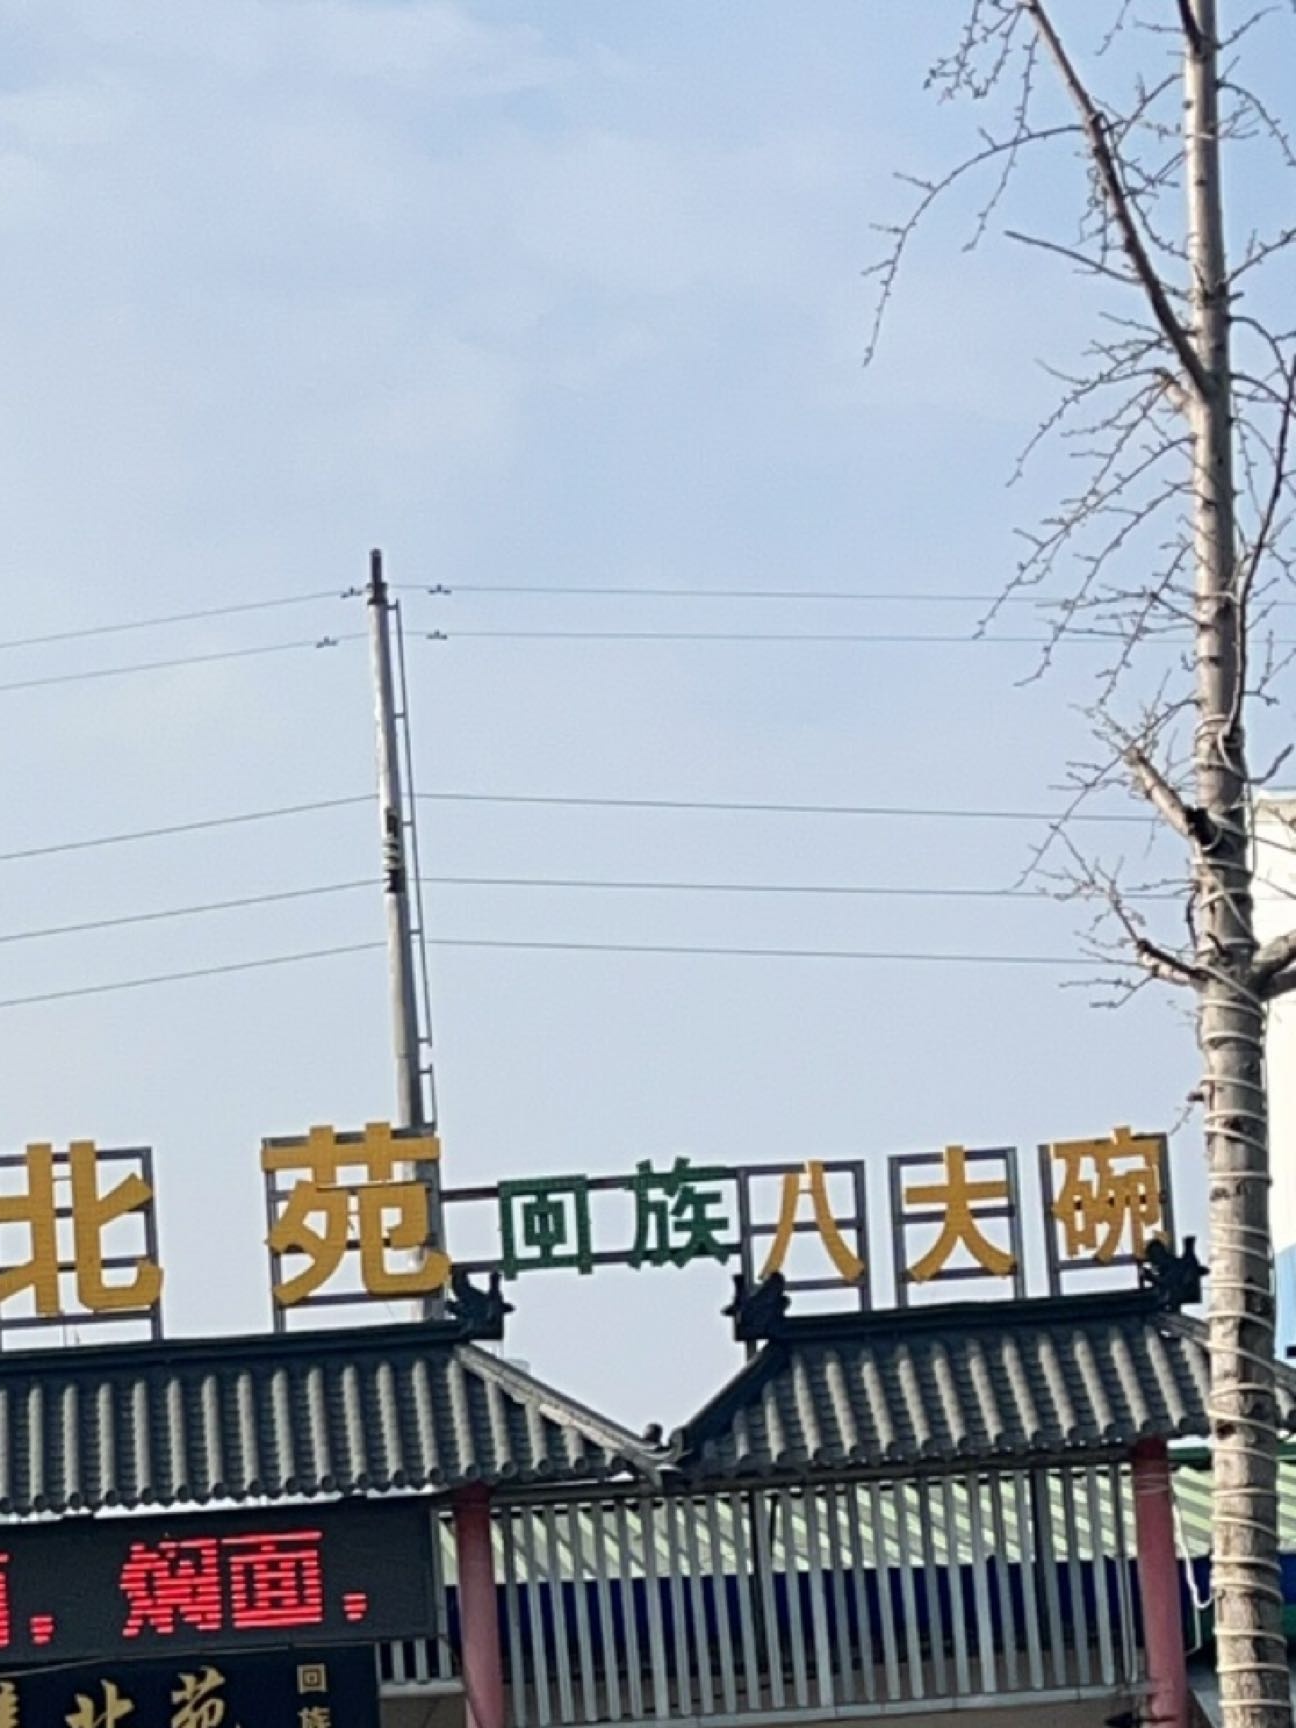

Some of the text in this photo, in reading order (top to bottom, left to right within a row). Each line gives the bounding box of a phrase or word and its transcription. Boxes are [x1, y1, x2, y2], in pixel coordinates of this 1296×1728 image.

[497, 1156, 729, 1281] 回族
[758, 1126, 1167, 1283] 八大碗
